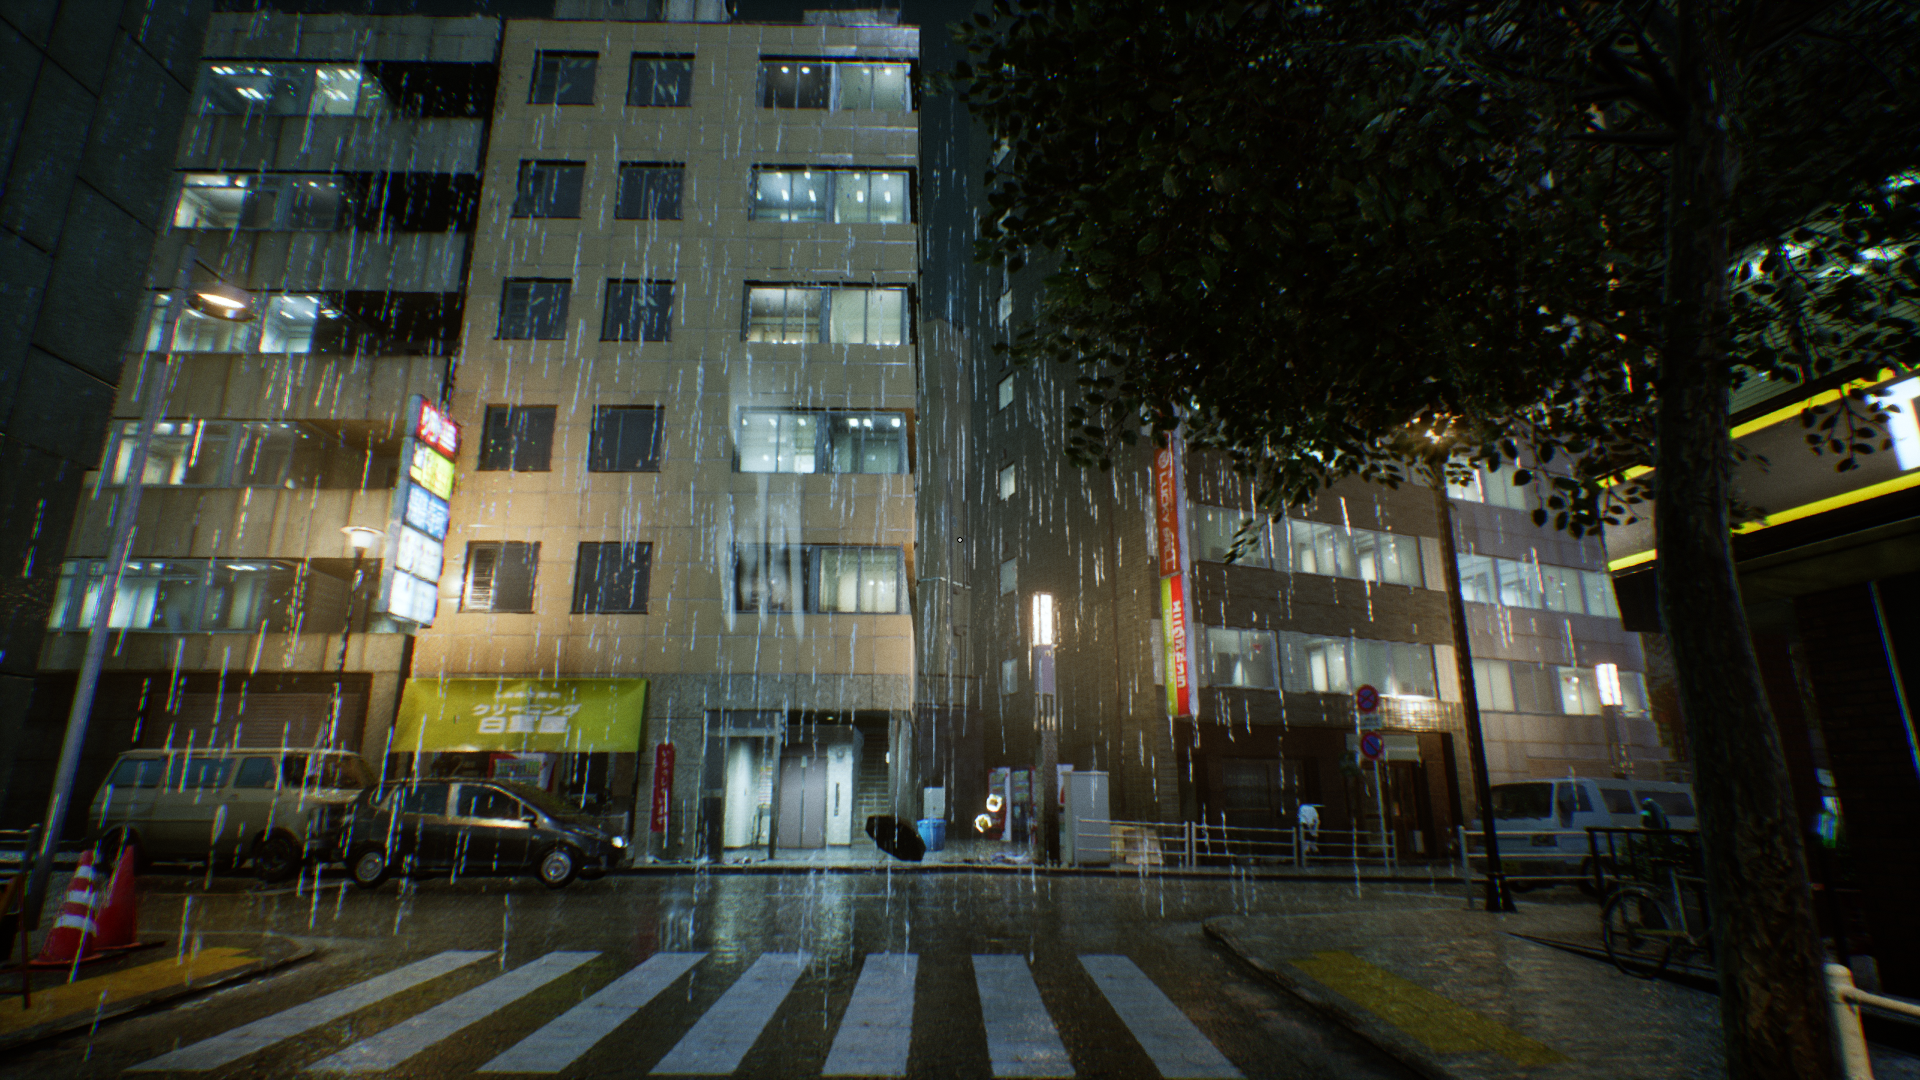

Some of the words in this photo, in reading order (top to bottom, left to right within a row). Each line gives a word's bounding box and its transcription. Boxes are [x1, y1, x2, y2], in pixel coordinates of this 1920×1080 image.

[472, 703, 582, 716] クリーニング
